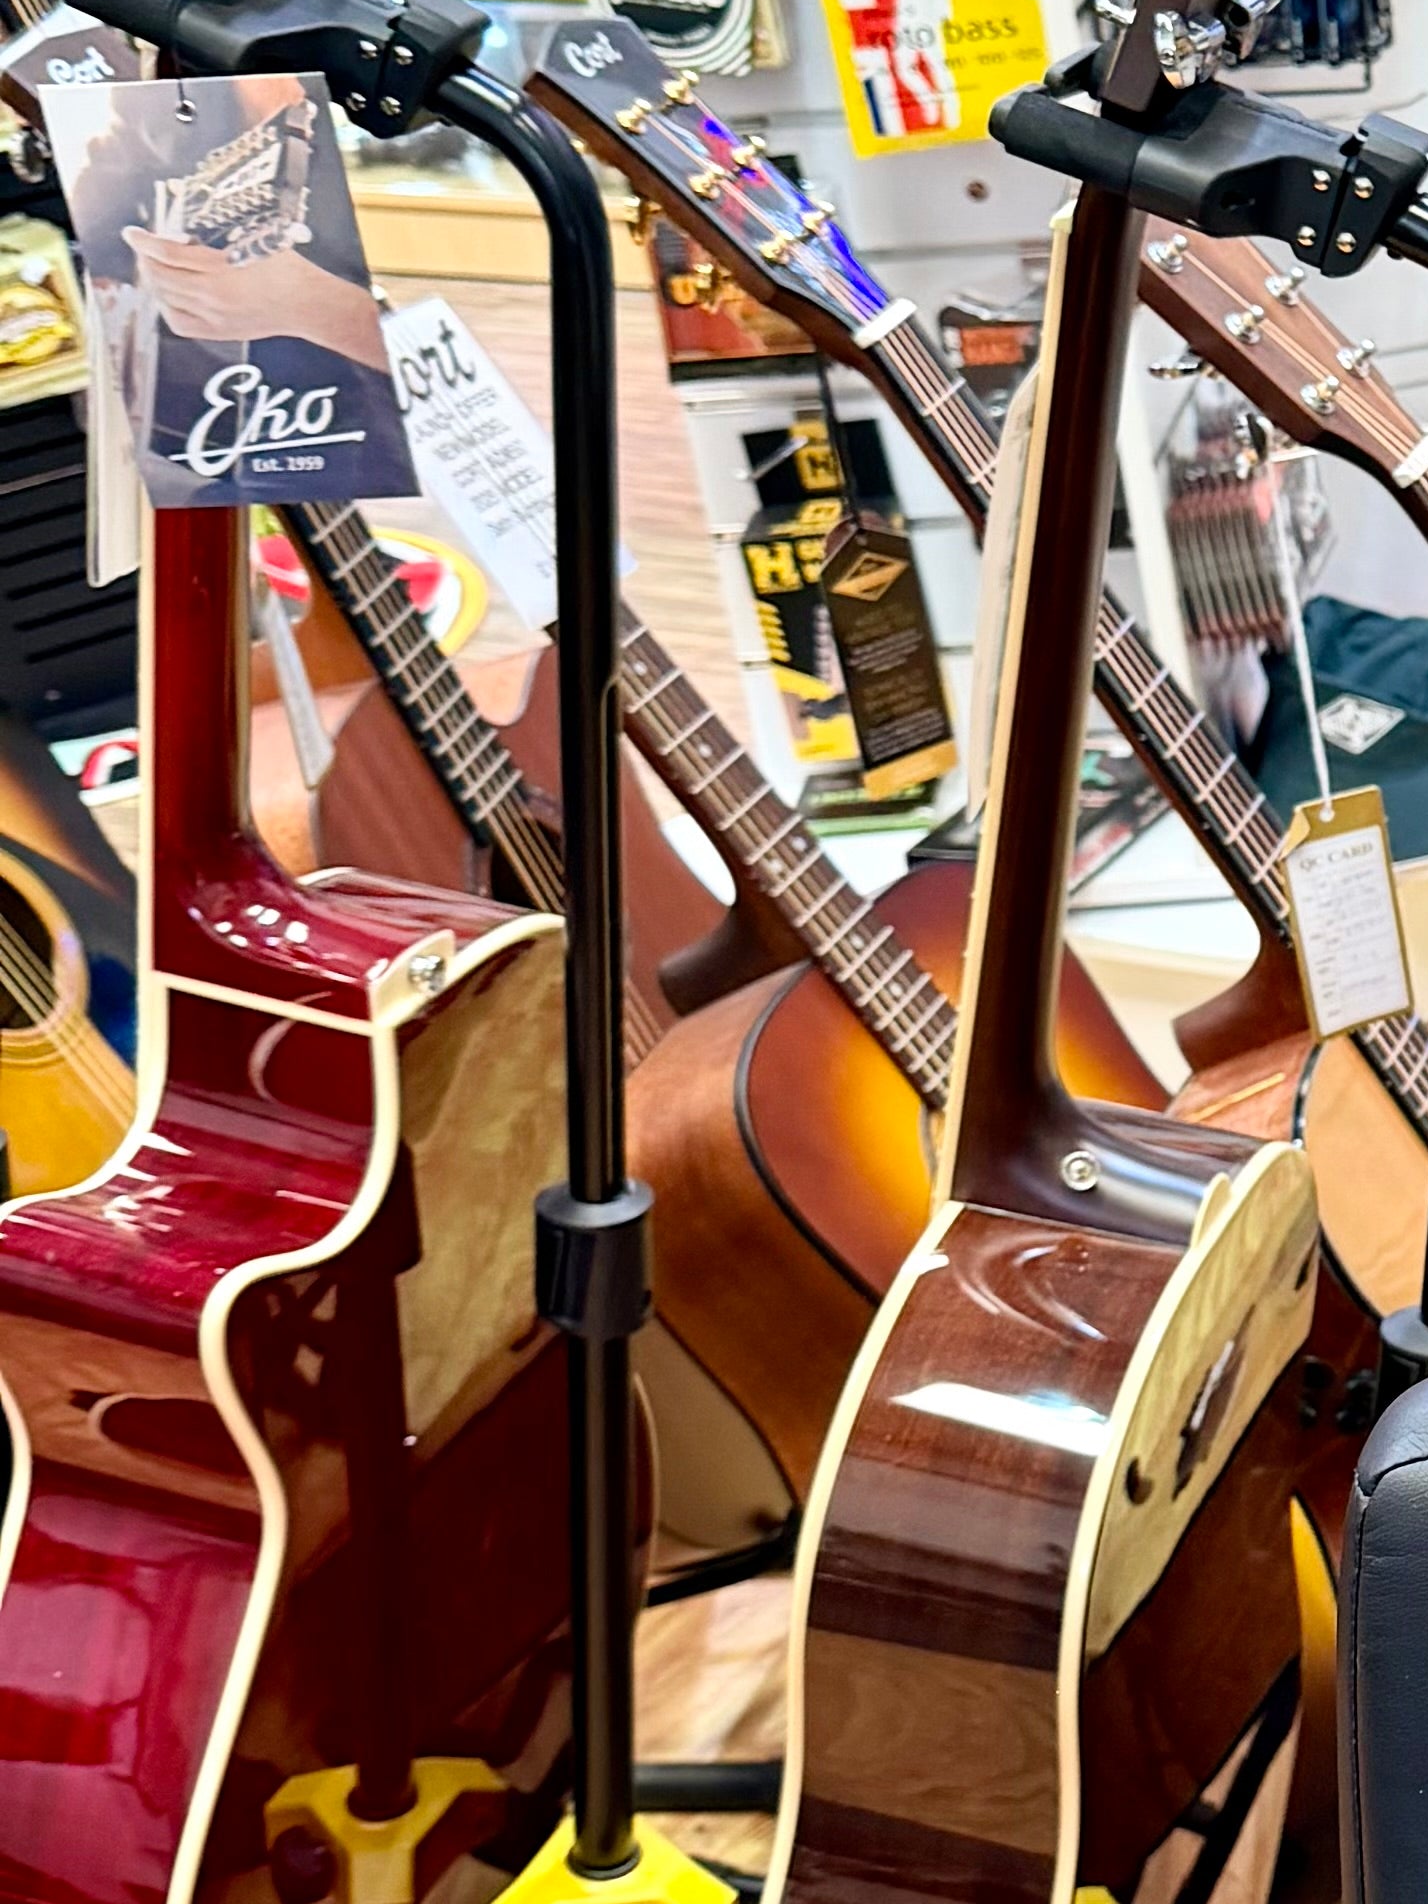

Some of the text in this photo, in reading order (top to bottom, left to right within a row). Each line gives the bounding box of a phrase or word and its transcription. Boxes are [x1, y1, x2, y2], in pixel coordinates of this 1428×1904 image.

[565, 31, 624, 78] Cort
[942, 16, 1020, 46] bass
[47, 45, 116, 85] Cort
[400, 318, 476, 415] ort
[186, 363, 340, 479] Eko
